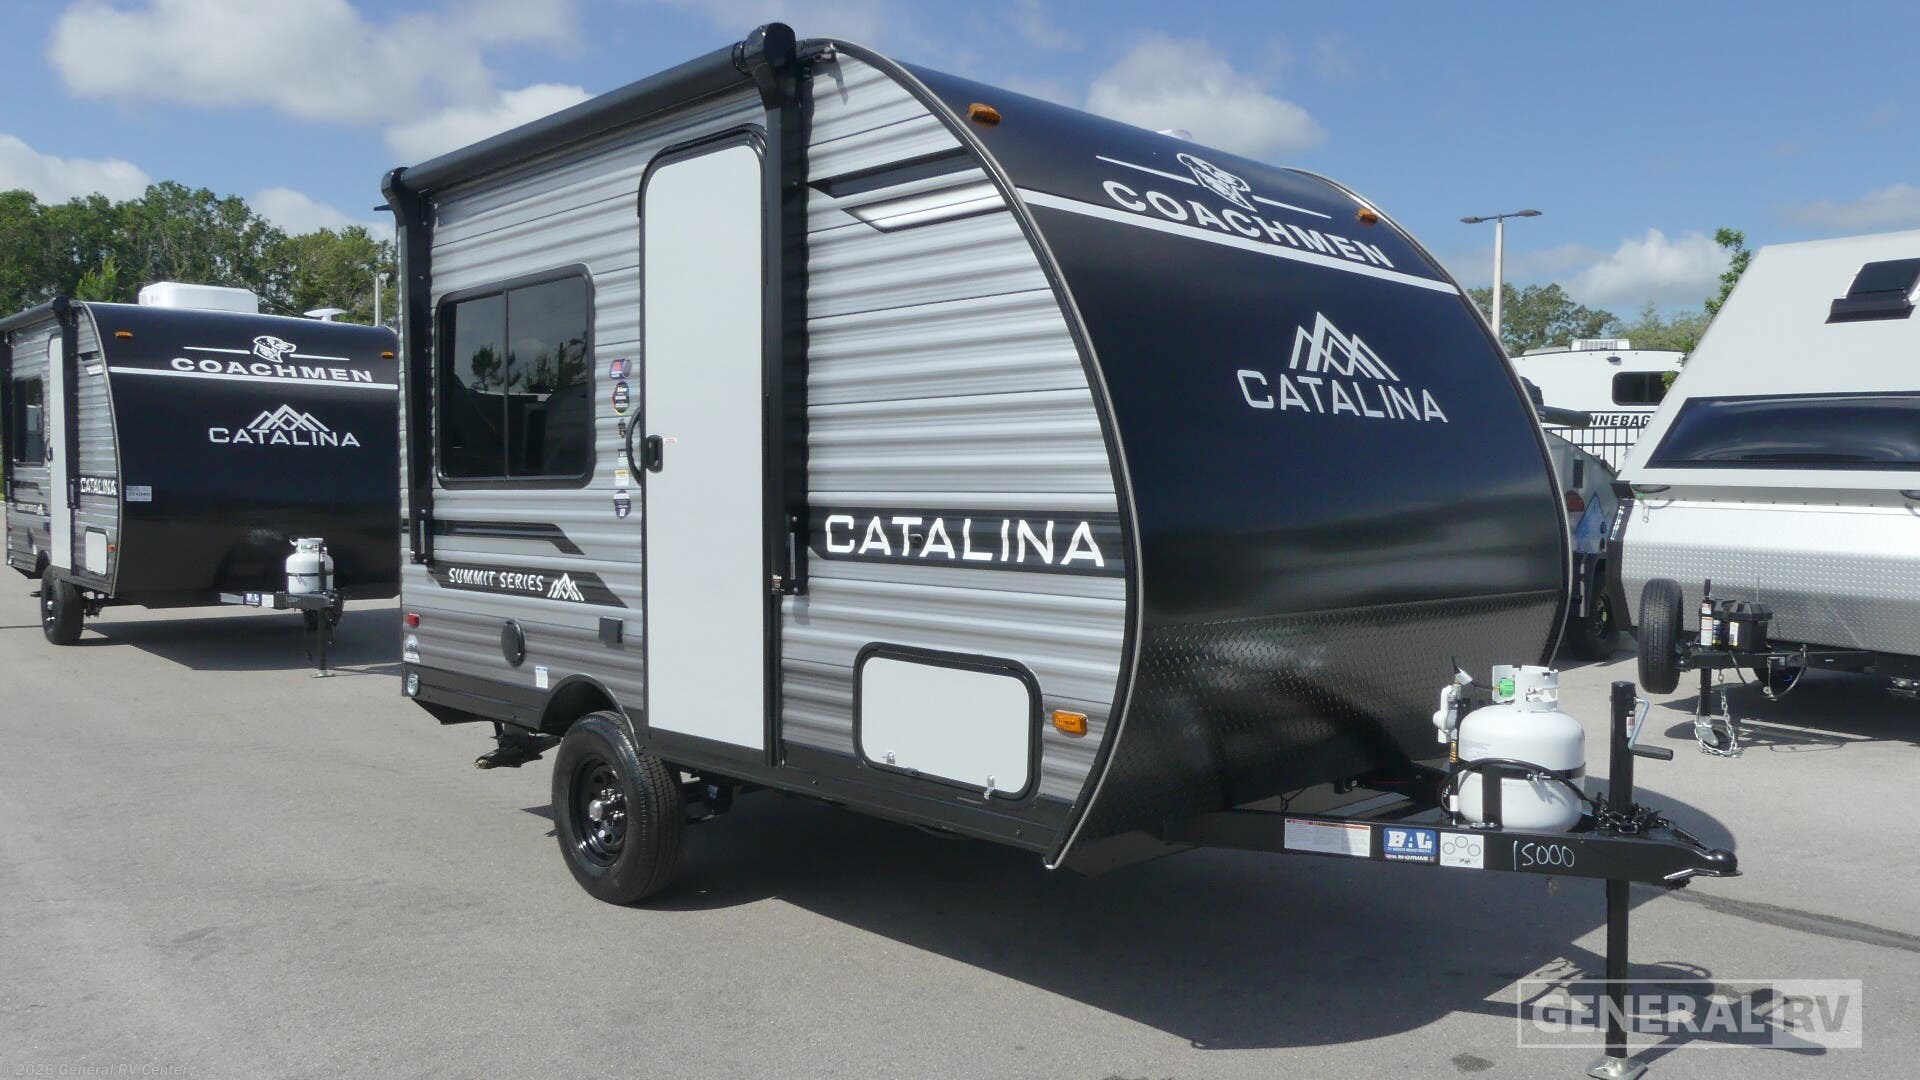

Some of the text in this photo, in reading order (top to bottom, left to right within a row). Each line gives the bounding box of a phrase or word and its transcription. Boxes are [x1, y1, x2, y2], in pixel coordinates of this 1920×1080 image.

[1102, 180, 1395, 269] COACHMEN
[171, 357, 374, 383] COACHMEN
[1236, 369, 1449, 423] CATALINA
[1590, 414, 1651, 427] NNEBAG
[208, 426, 361, 447] CATALINA
[80, 477, 117, 496] CATALINA
[825, 514, 1105, 568] CATALINA
[449, 567, 544, 592] SUMMIT SERIES
[1513, 840, 1575, 872] 15000
